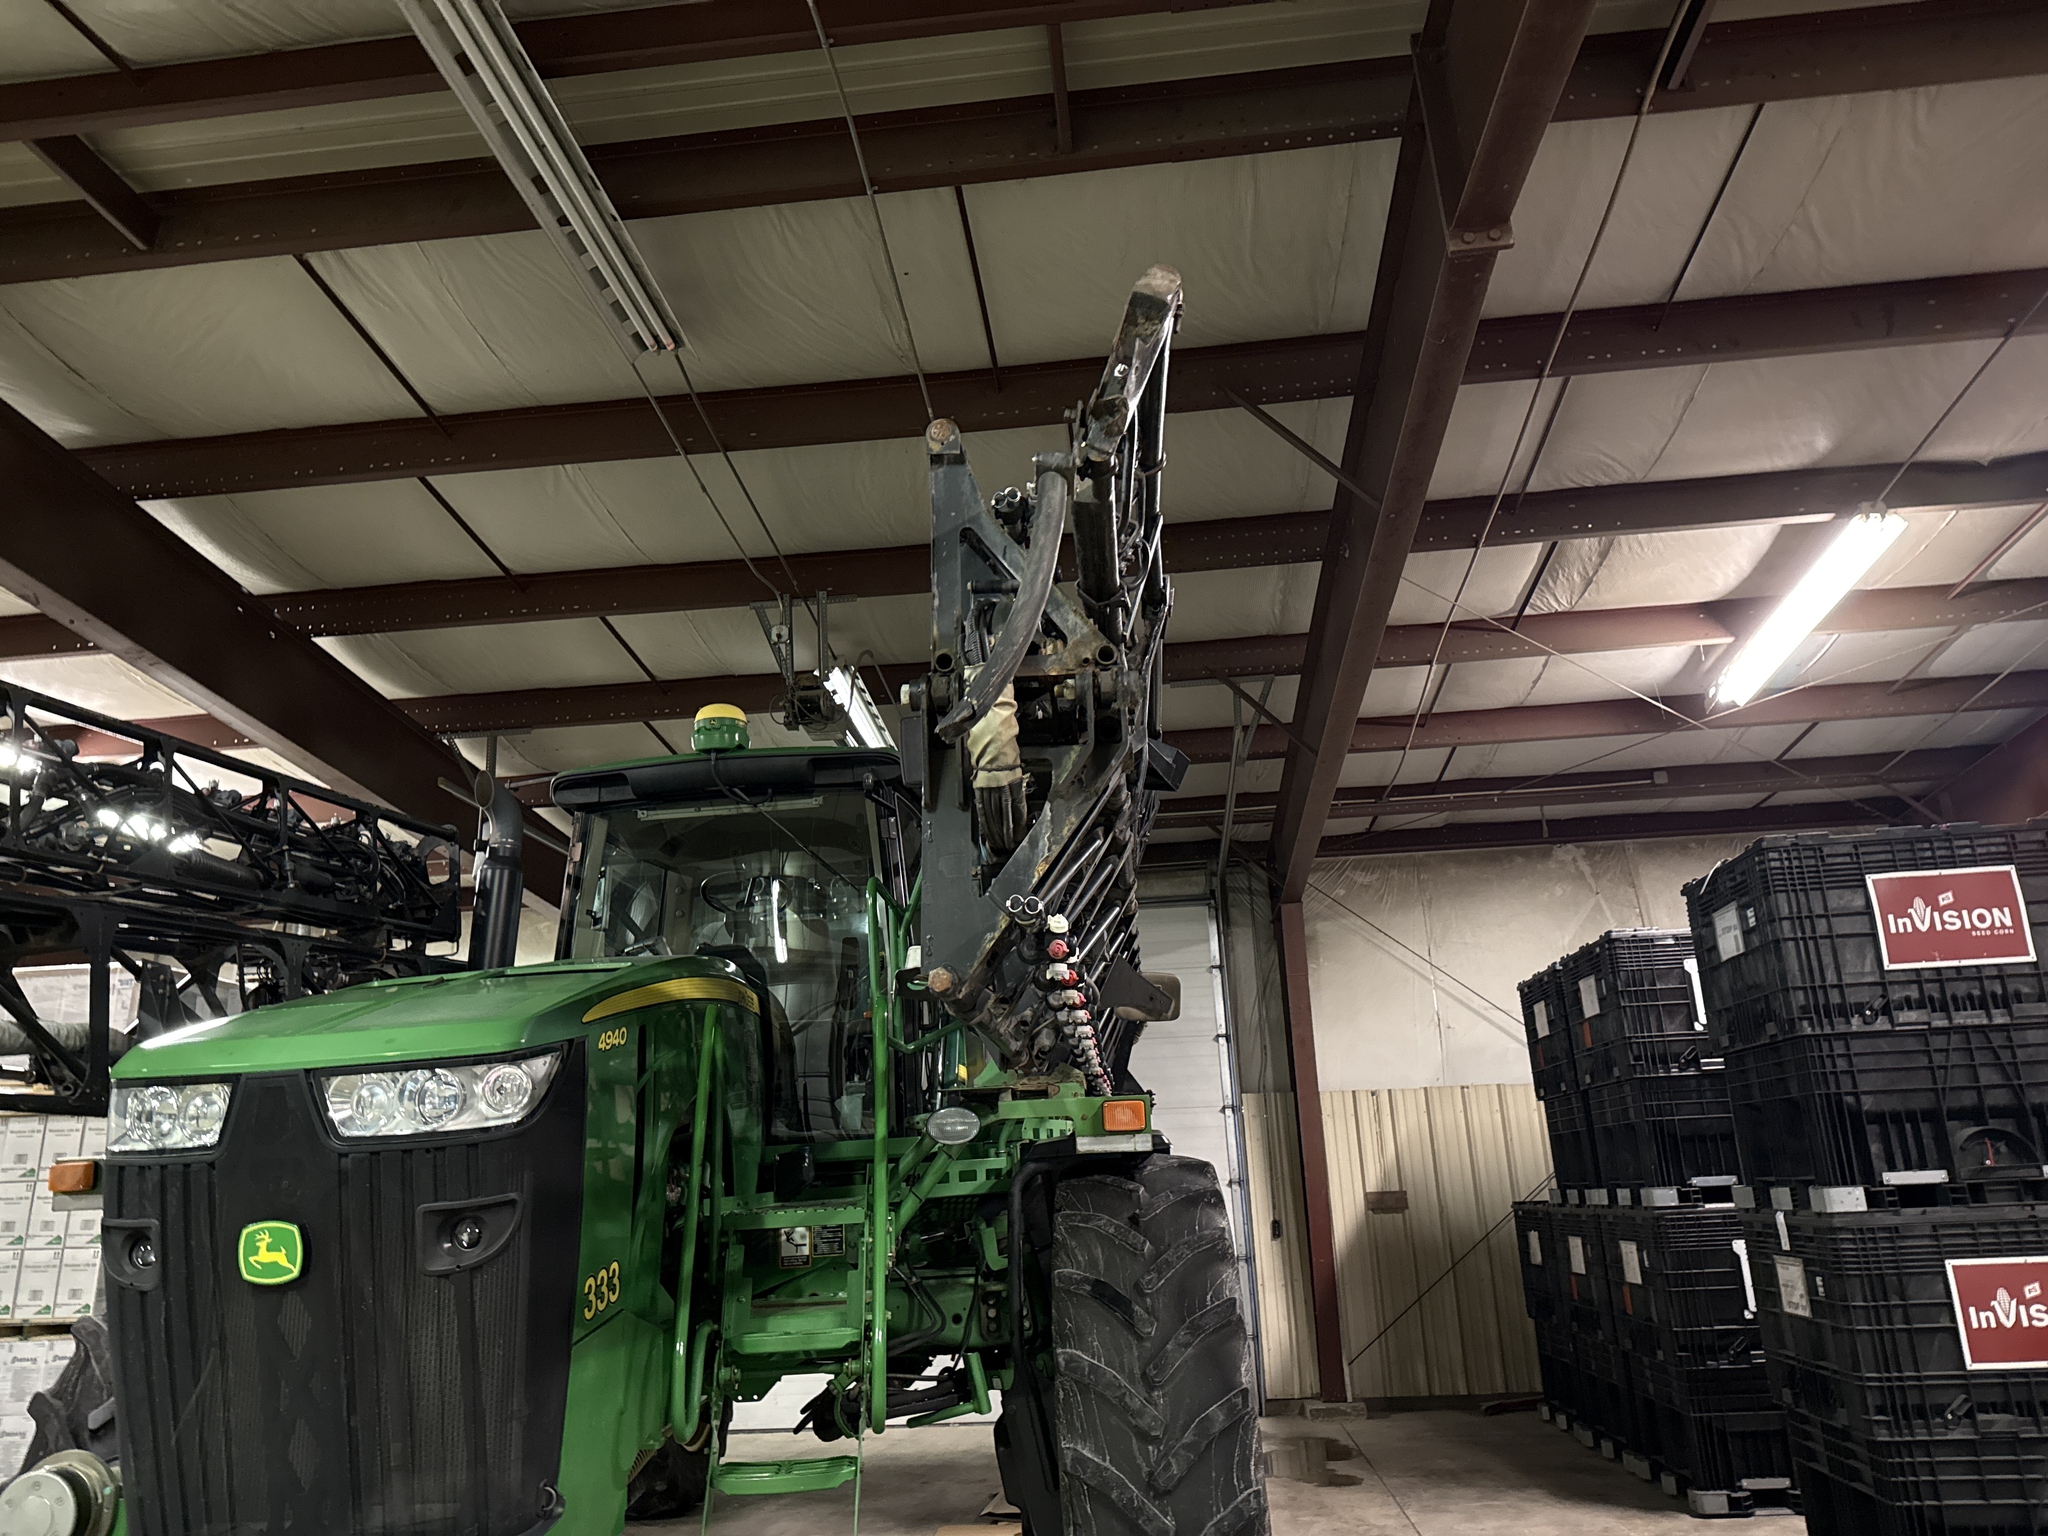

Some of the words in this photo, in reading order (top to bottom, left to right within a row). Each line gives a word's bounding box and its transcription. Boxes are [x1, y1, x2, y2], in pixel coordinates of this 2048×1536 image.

[1887, 905, 2013, 933] InVISION
[598, 1026, 627, 1051] 4940
[584, 1260, 620, 1320] 333
